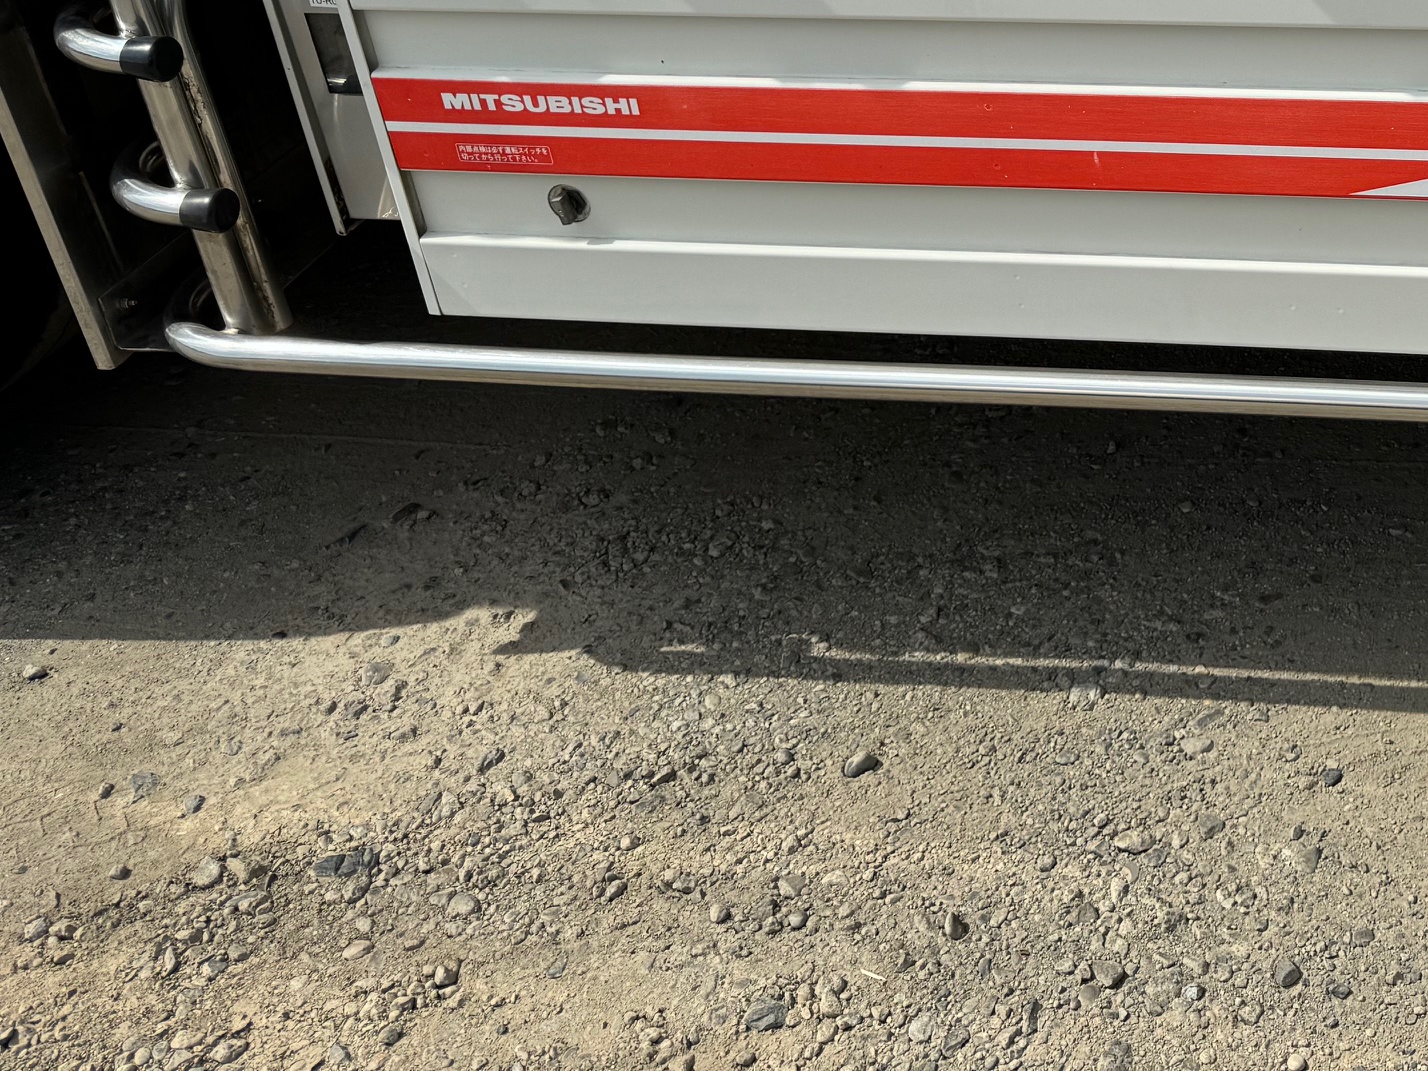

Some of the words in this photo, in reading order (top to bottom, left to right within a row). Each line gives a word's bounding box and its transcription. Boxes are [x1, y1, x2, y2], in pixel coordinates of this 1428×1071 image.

[441, 93, 640, 115] MITSUBISHI
[459, 145, 548, 155] 内部点検は必ず運転スイッチを
[462, 153, 539, 162] 切ってから行って下さい。
